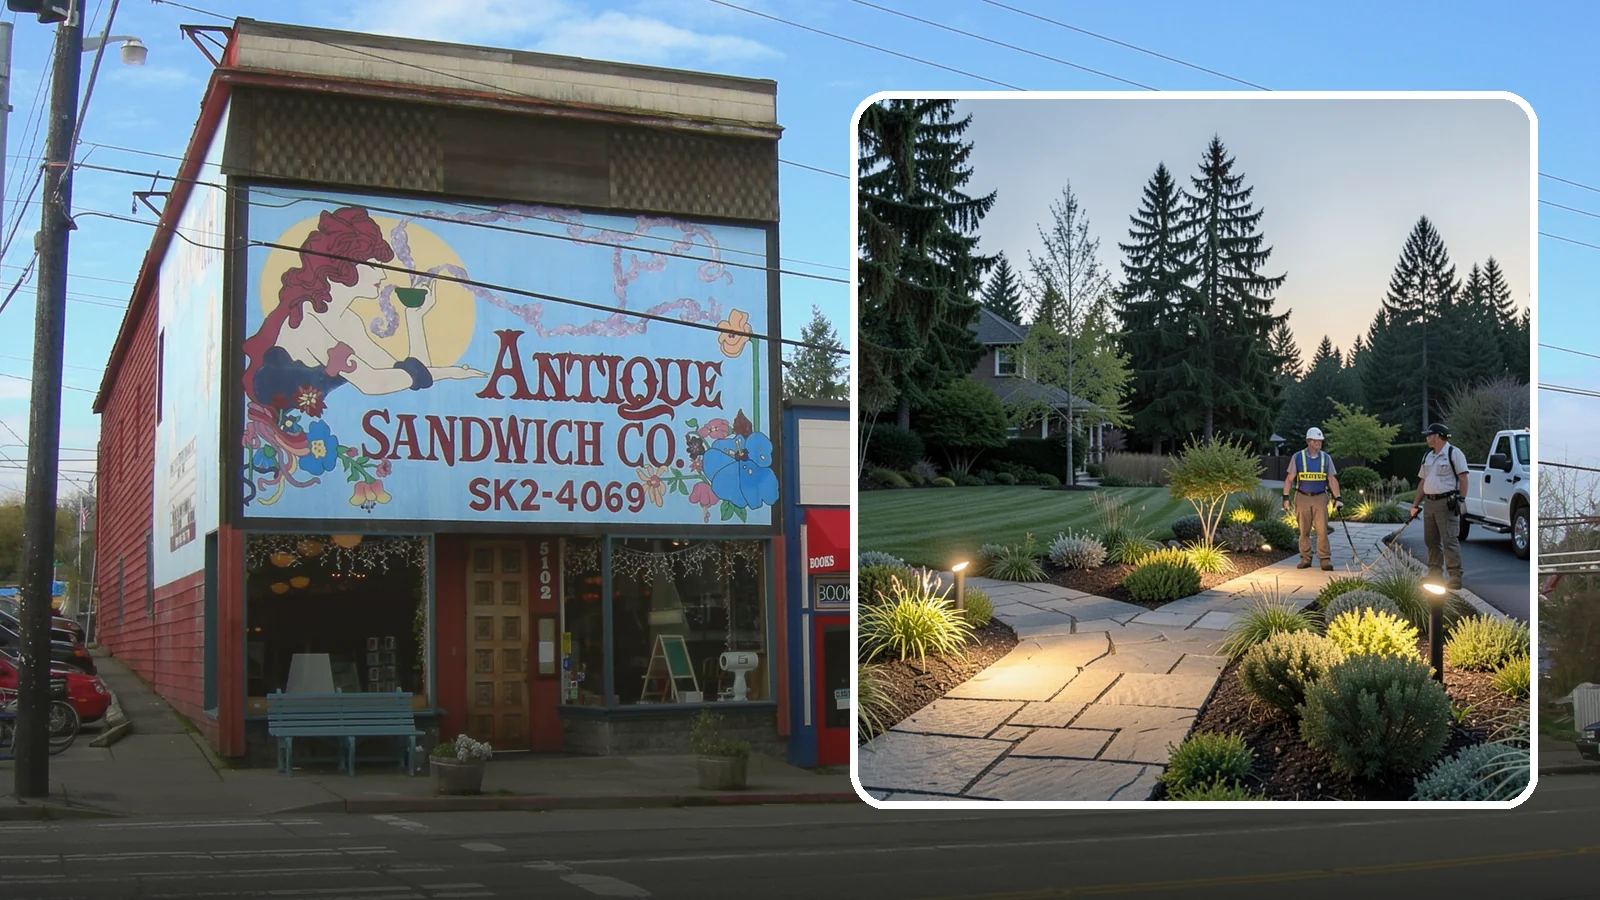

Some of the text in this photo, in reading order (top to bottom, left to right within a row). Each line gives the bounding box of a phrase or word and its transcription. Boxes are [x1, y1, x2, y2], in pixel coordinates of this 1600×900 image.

[476, 329, 723, 420] ANTIQUE
[361, 408, 684, 469] SANDWICH CO.
[468, 477, 646, 512] SK2-4069
[540, 541, 551, 599] 5102
[809, 555, 834, 568] BOOKS
